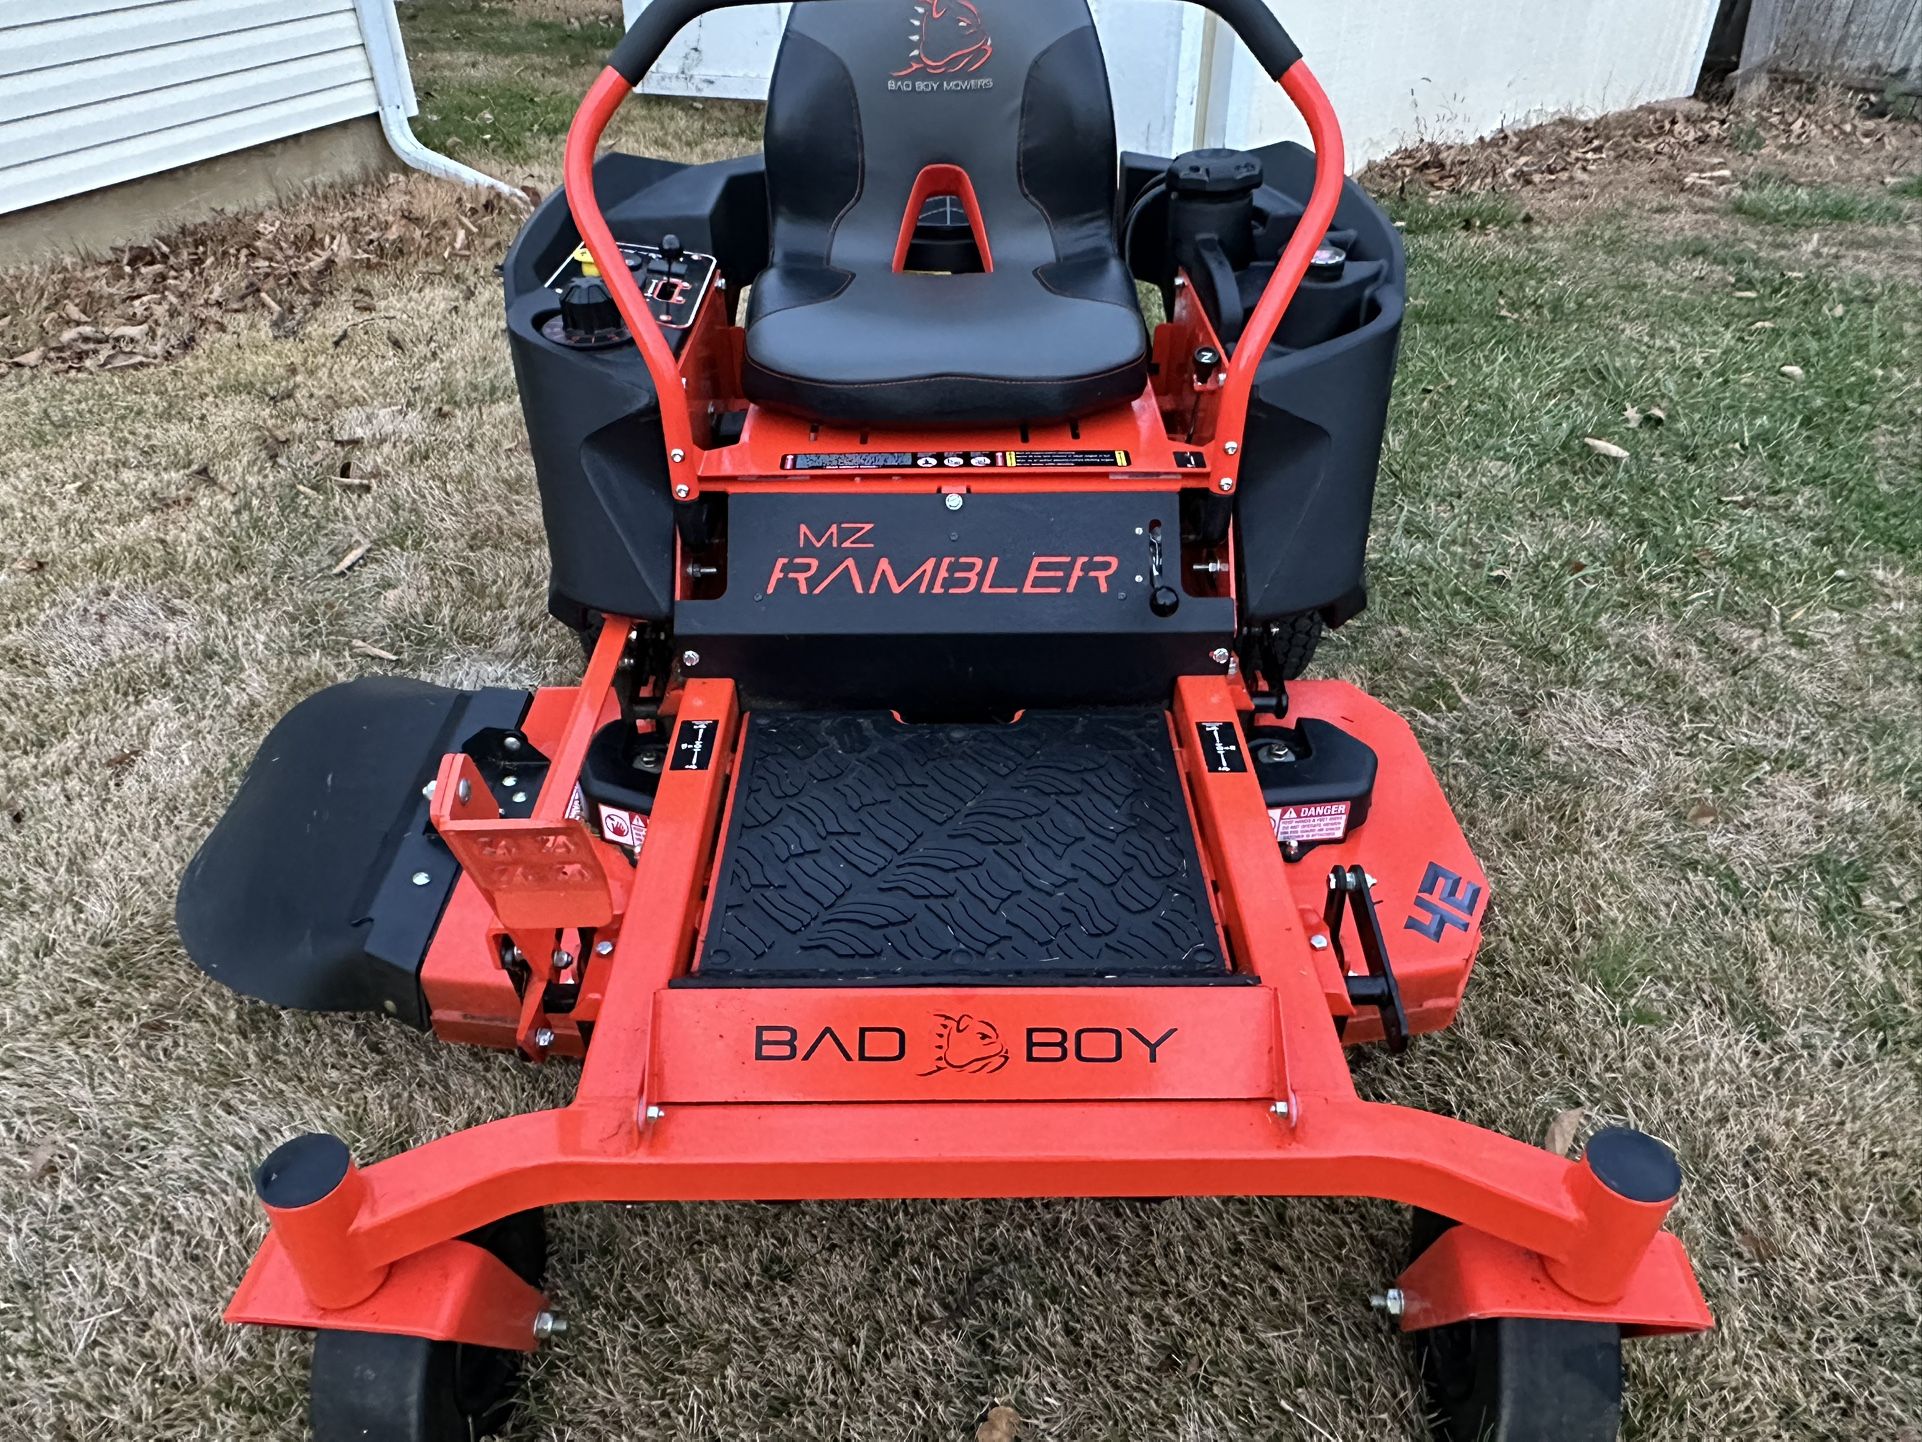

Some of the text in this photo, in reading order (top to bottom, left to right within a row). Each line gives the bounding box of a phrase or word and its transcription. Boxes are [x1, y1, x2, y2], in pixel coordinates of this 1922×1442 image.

[915, 81, 940, 92] BOY
[800, 523, 875, 548] MZ
[766, 556, 1119, 595] RAMBLER
[1300, 805, 1346, 817] DANGER
[1404, 861, 1482, 943] 42
[755, 1026, 1178, 1063] BAD BOY
